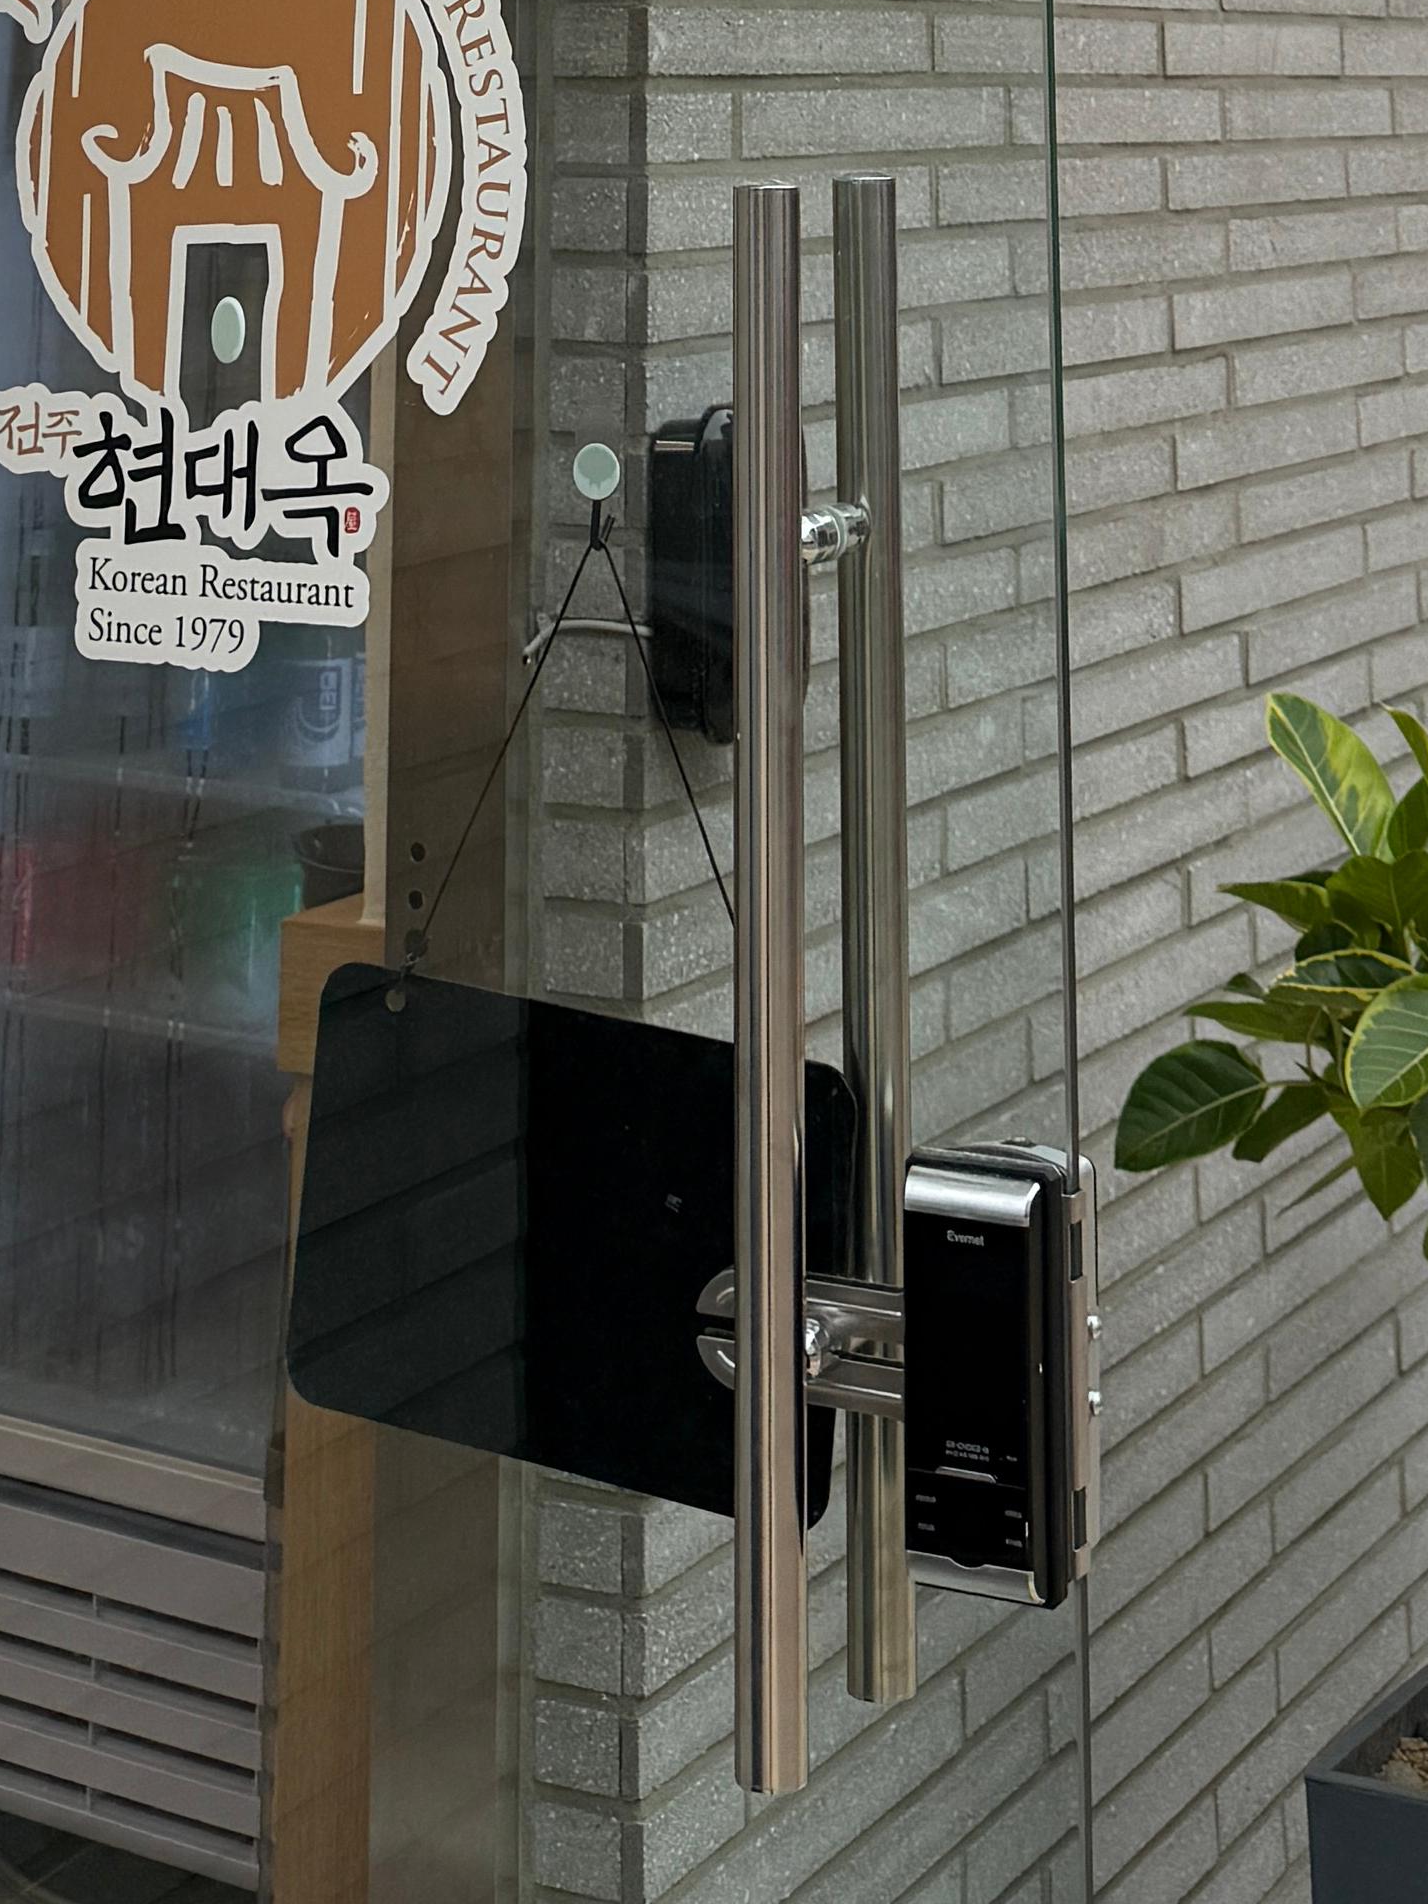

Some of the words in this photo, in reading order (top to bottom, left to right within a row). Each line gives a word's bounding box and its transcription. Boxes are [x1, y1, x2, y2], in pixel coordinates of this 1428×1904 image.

[72, 407, 373, 558] 현대옥
[88, 557, 188, 597] Korean
[199, 564, 355, 609] Restaurant
[88, 608, 163, 645] Since
[174, 616, 246, 655] 1979
